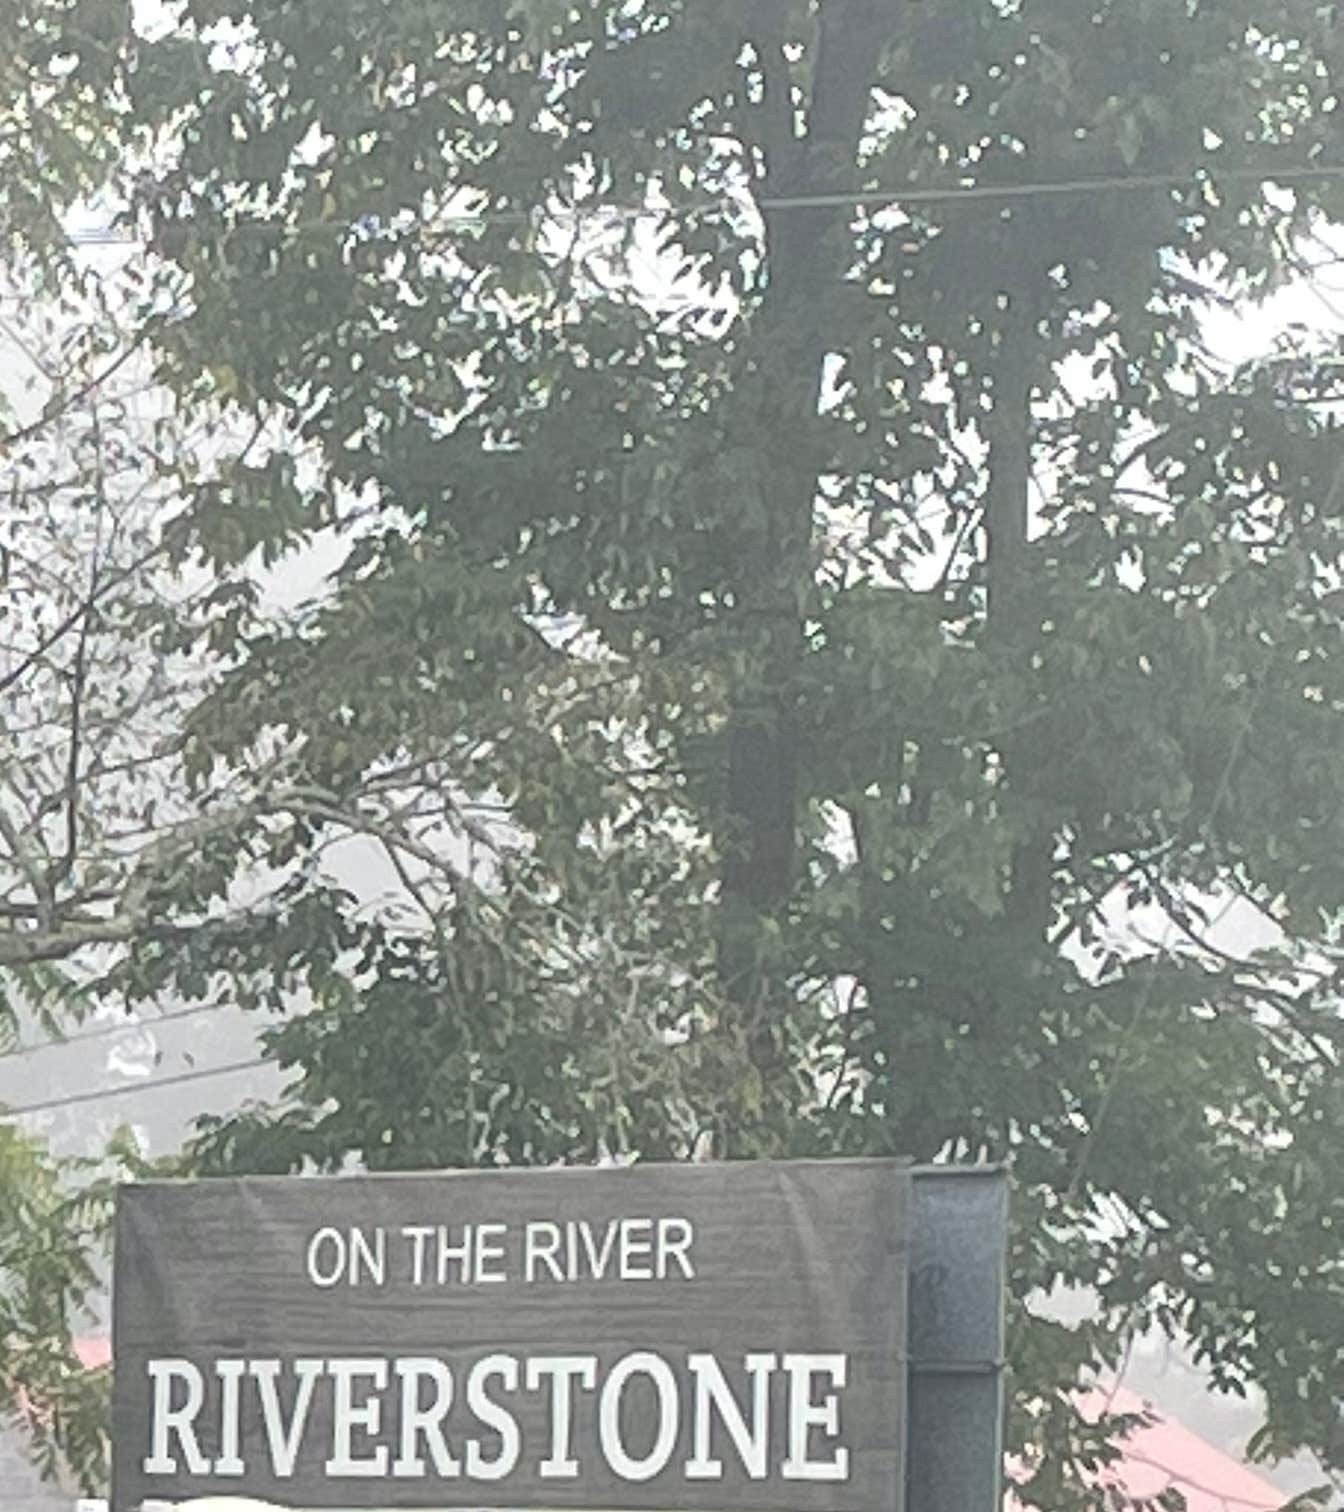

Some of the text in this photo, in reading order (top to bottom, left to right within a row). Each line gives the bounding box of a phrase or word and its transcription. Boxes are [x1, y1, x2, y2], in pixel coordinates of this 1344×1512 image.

[307, 1218, 694, 1287] ON THE RIVER
[145, 1352, 850, 1481] RIVERSTONE
